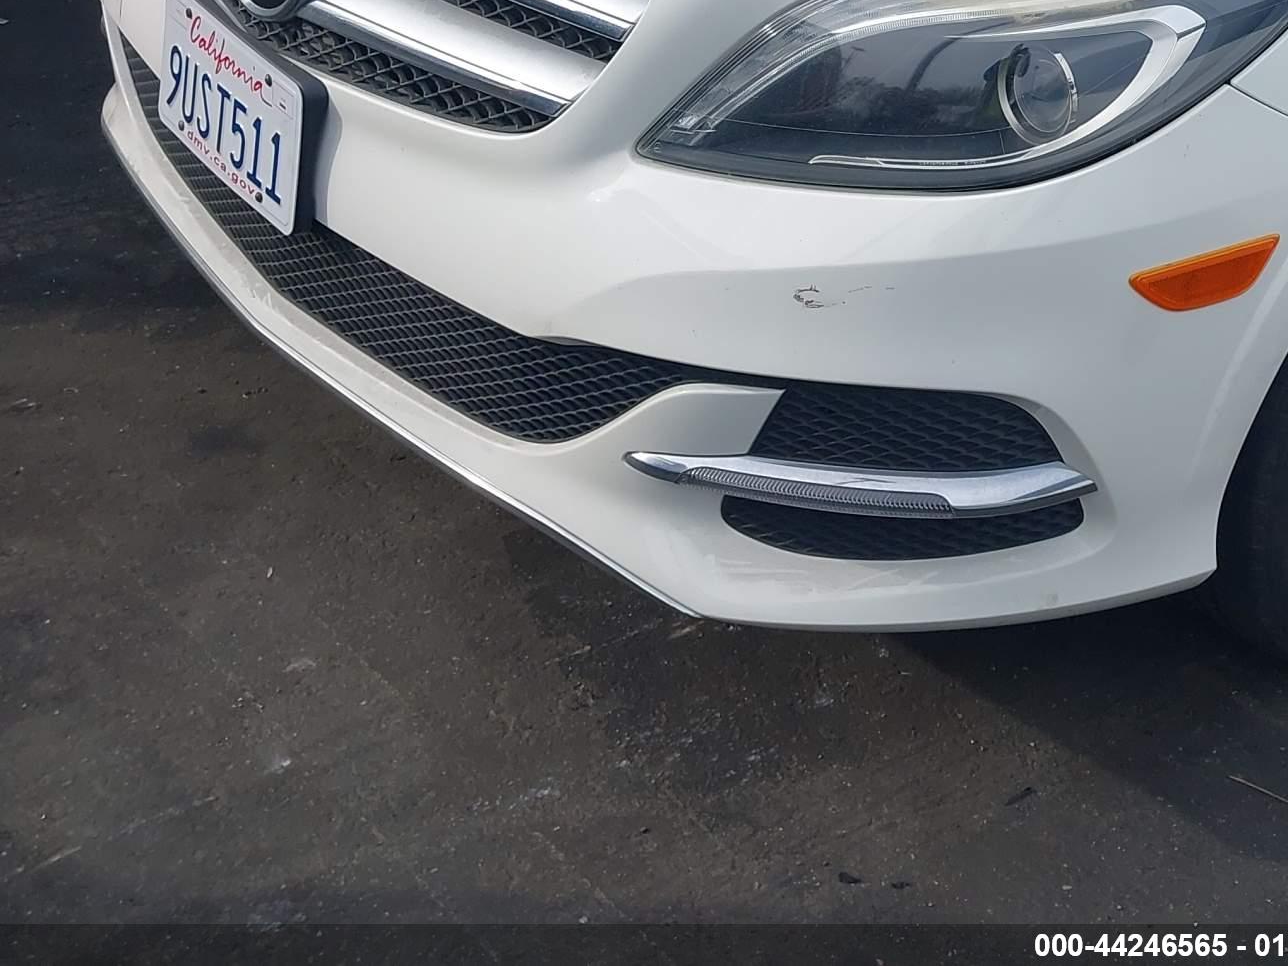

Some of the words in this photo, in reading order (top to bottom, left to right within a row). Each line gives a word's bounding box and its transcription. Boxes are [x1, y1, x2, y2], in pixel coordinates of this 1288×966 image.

[190, 15, 273, 108] California
[166, 44, 282, 206] 9UST511
[187, 130, 255, 195] dmv.ca.gov
